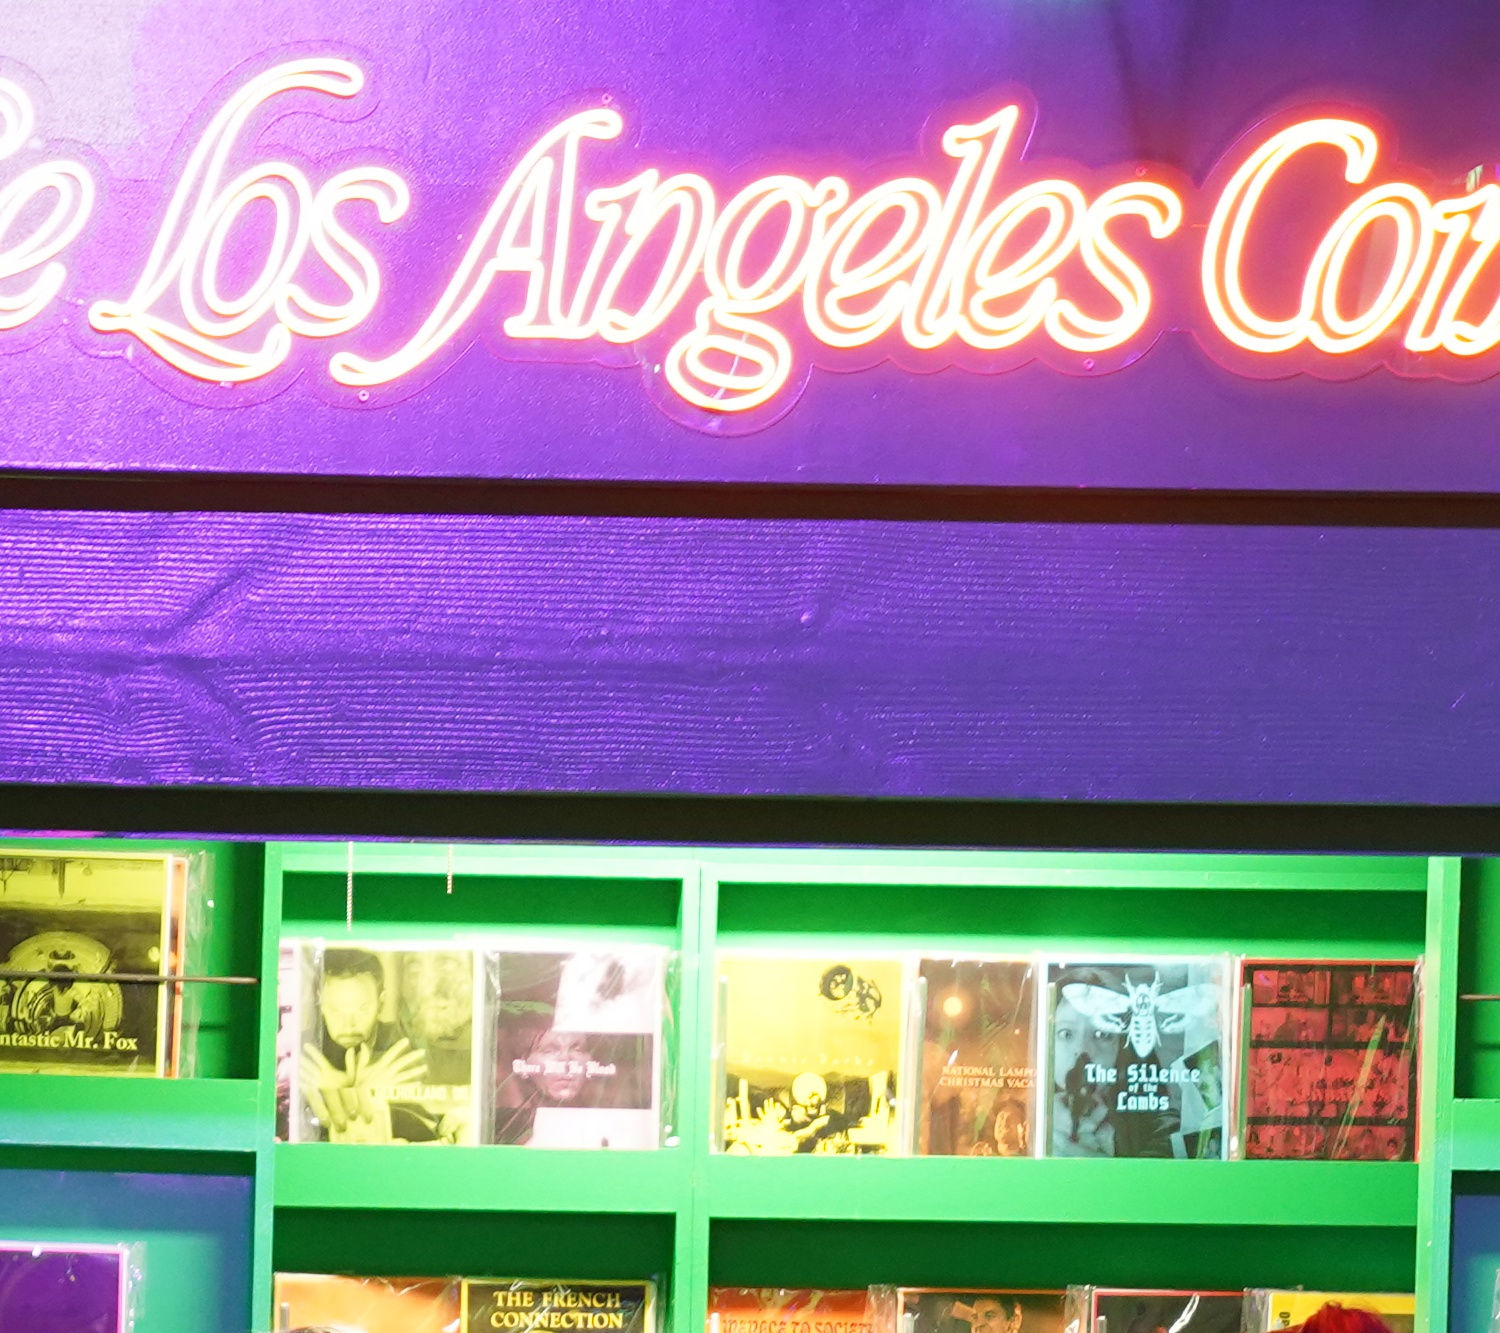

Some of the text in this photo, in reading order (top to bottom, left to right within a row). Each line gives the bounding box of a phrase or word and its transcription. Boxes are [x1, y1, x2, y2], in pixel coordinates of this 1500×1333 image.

[90, 58, 410, 384] Los
[332, 103, 1182, 414] Angeles
[63, 1031, 98, 1049] Mr.
[103, 1032, 138, 1051] Fox
[943, 1066, 995, 1077] NATIONAL
[1084, 1063, 1200, 1083] The Silence
[939, 1076, 1004, 1089] CHRISTMAS
[1142, 1084, 1158, 1093] the
[1116, 1092, 1170, 1111] Lambs
[493, 1290, 621, 1310] THE FRENCH
[490, 1310, 624, 1330] CONNECTION
